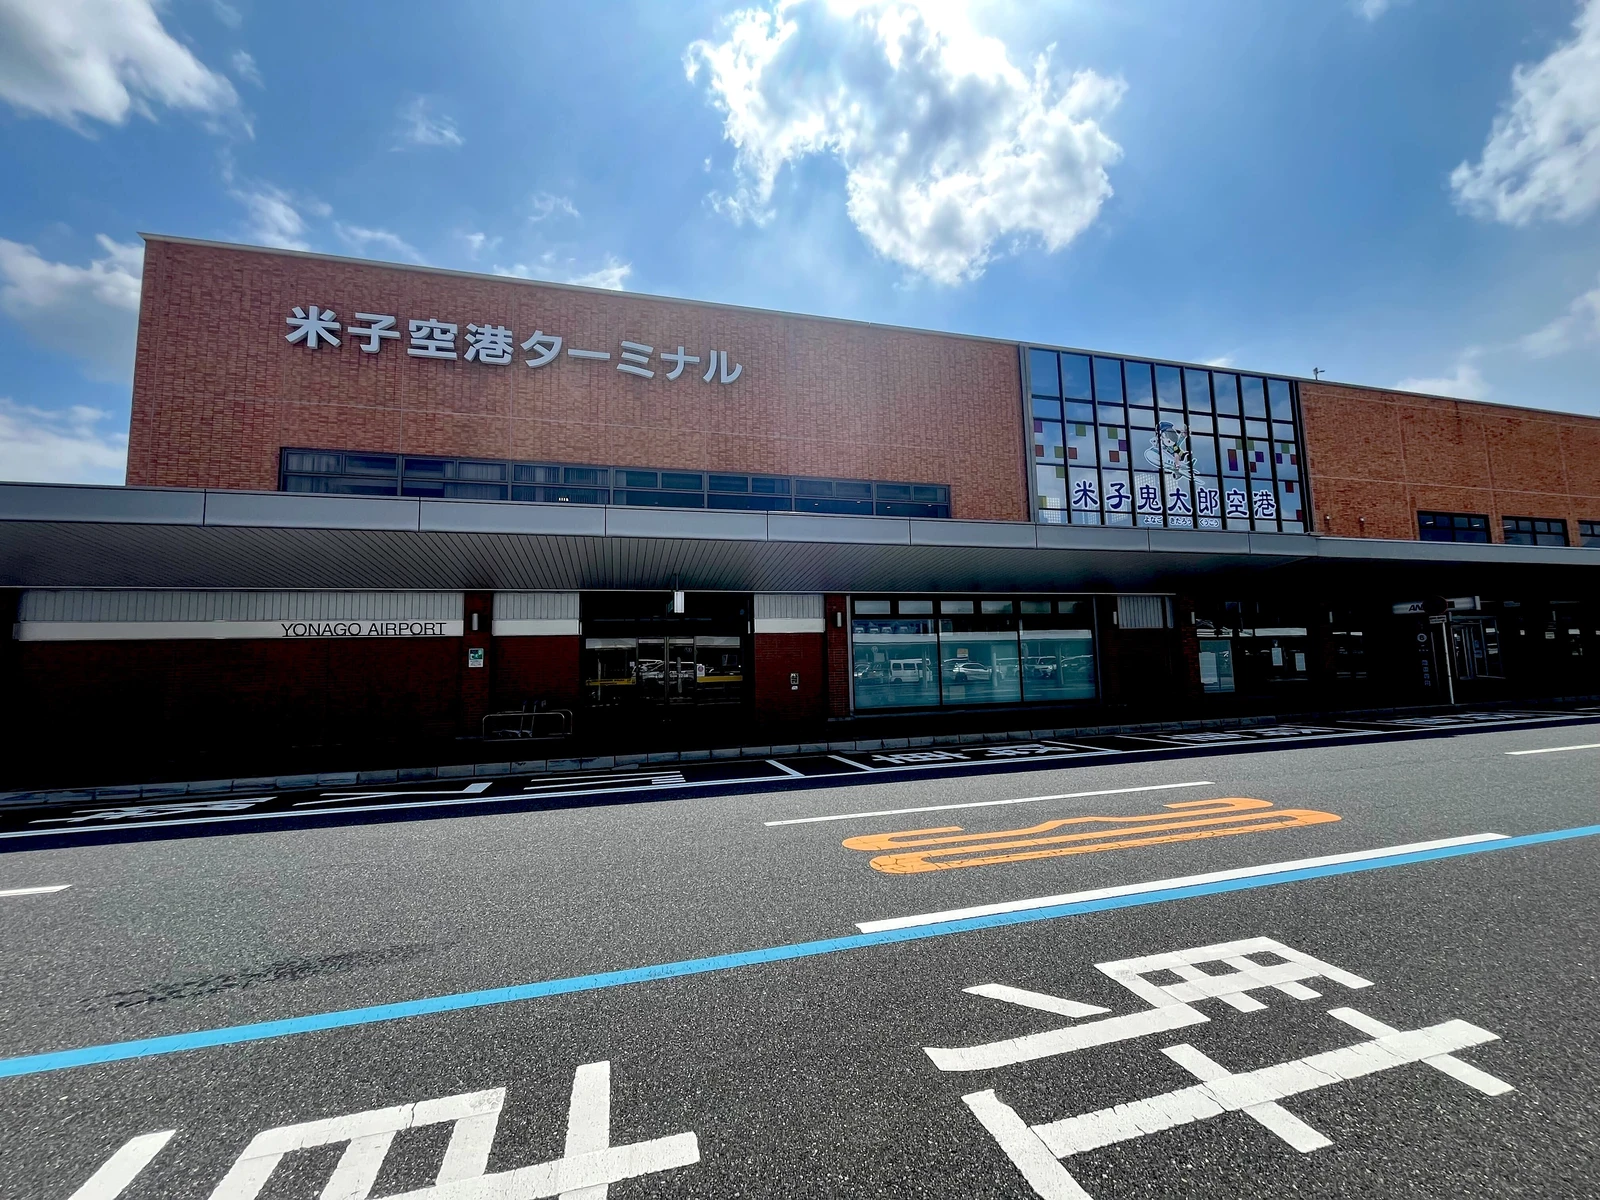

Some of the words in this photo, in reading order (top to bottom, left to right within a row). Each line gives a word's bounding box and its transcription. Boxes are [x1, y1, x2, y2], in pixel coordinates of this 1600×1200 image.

[285, 305, 743, 385] 米子空港ターミナル
[1072, 479, 1277, 519] 米子鬼太郎空港
[1144, 515, 1164, 524] よなご
[1169, 516, 1193, 526] きたろう
[1199, 517, 1220, 527] くうこう
[281, 622, 362, 637] YONAGO
[368, 622, 447, 636] AIRPORT
[842, 797, 1342, 875] 30
